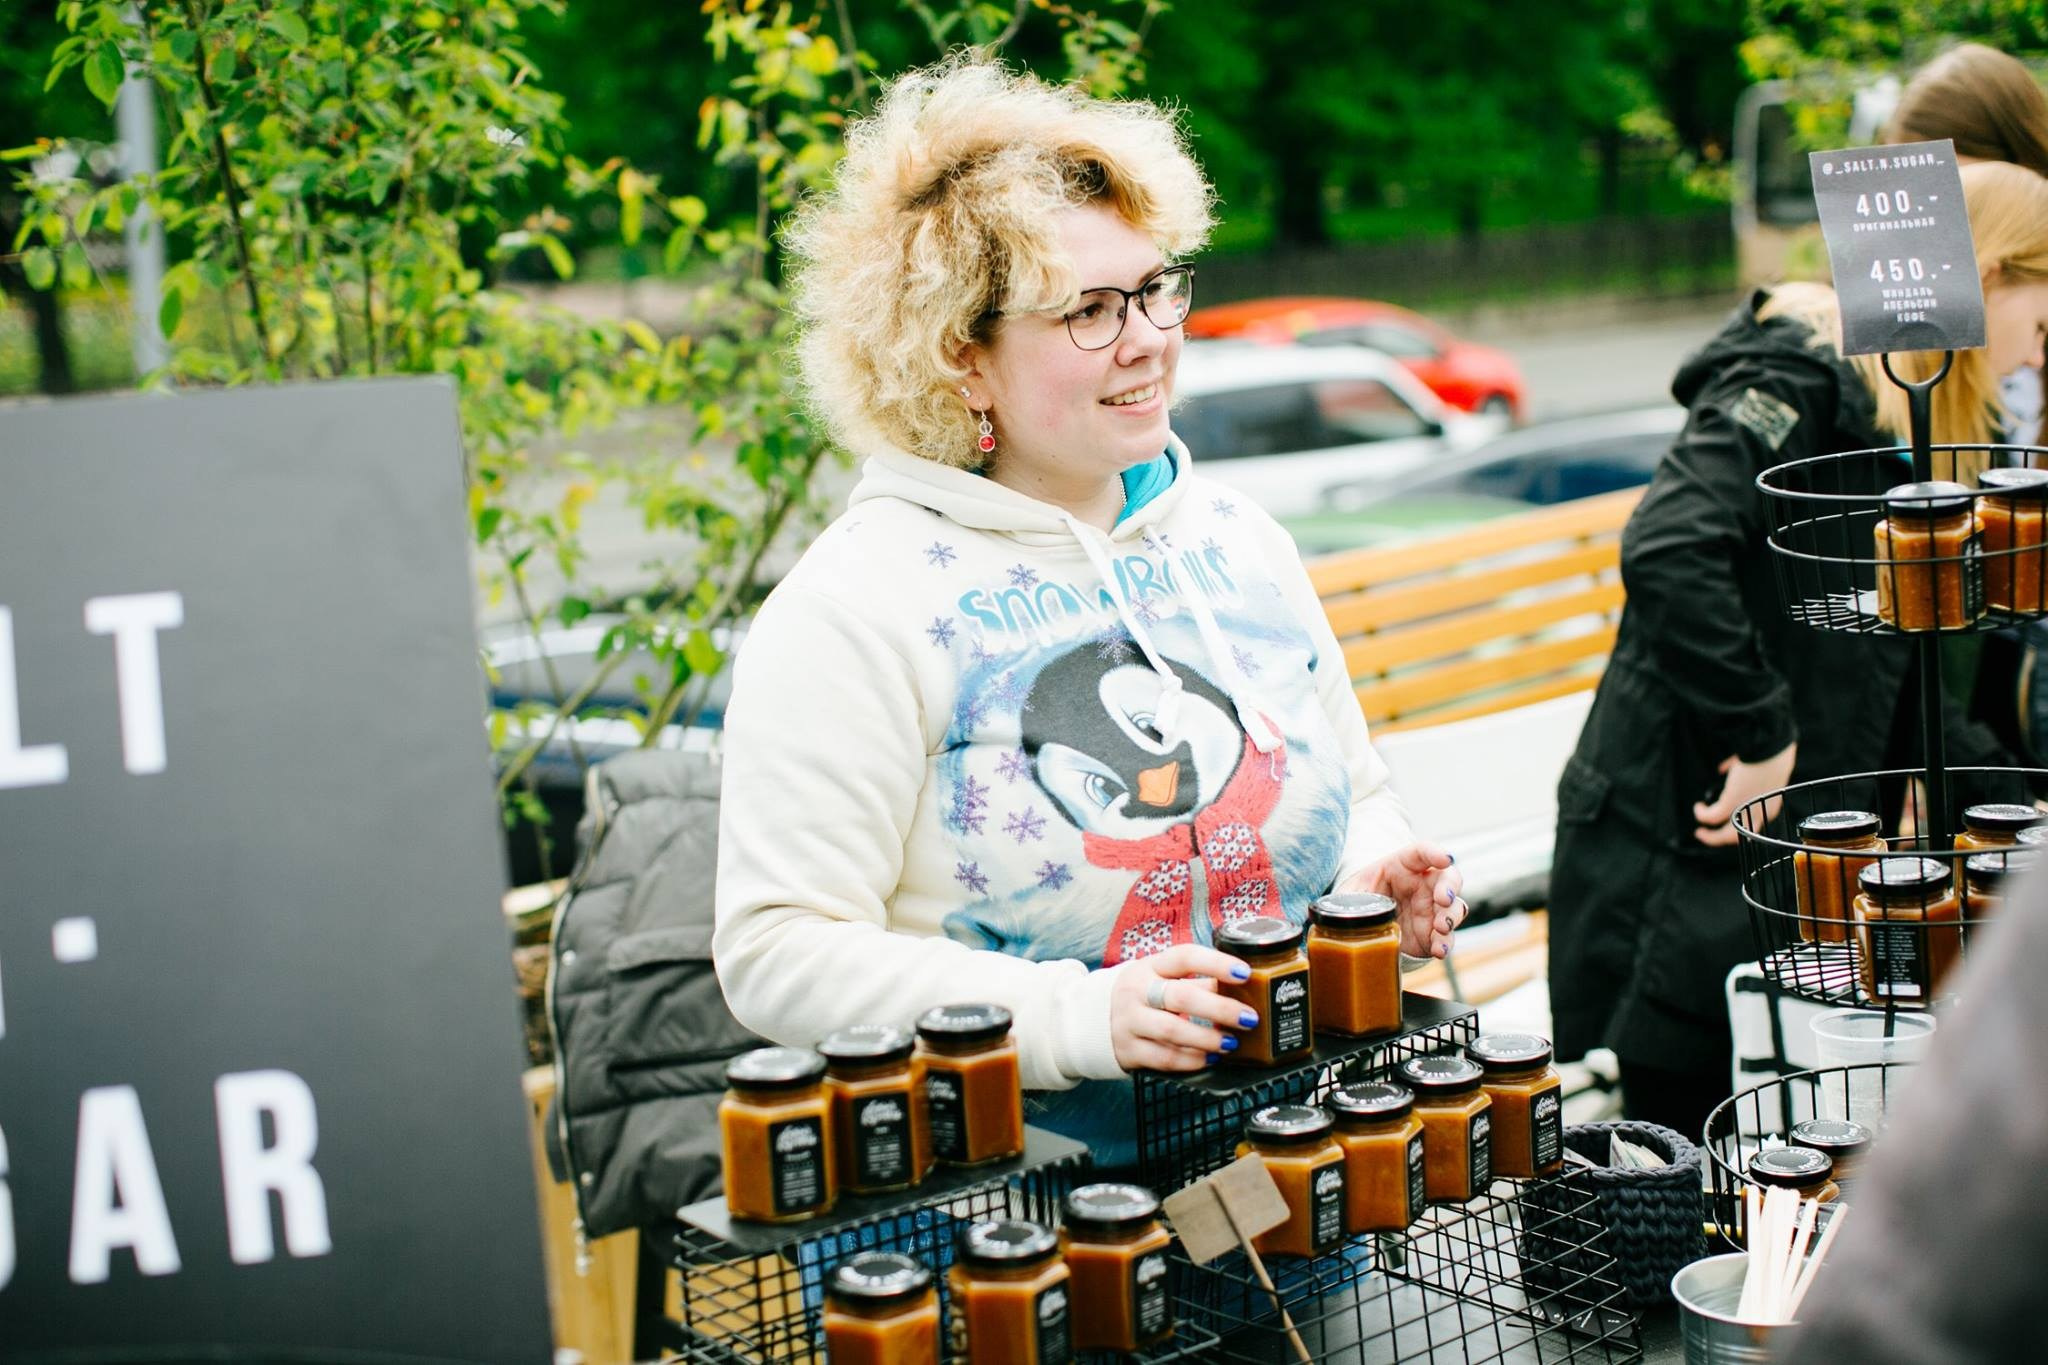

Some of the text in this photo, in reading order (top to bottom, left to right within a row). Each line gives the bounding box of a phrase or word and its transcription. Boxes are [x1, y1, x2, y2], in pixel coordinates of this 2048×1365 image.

[1853, 217, 1936, 232] ОРИГИНАЛЬНАЯ
[1883, 299, 1938, 312] АПЕЛЬСИН
[1896, 311, 1926, 323] КОФЕ
[0, 1068, 333, 1292] AR
